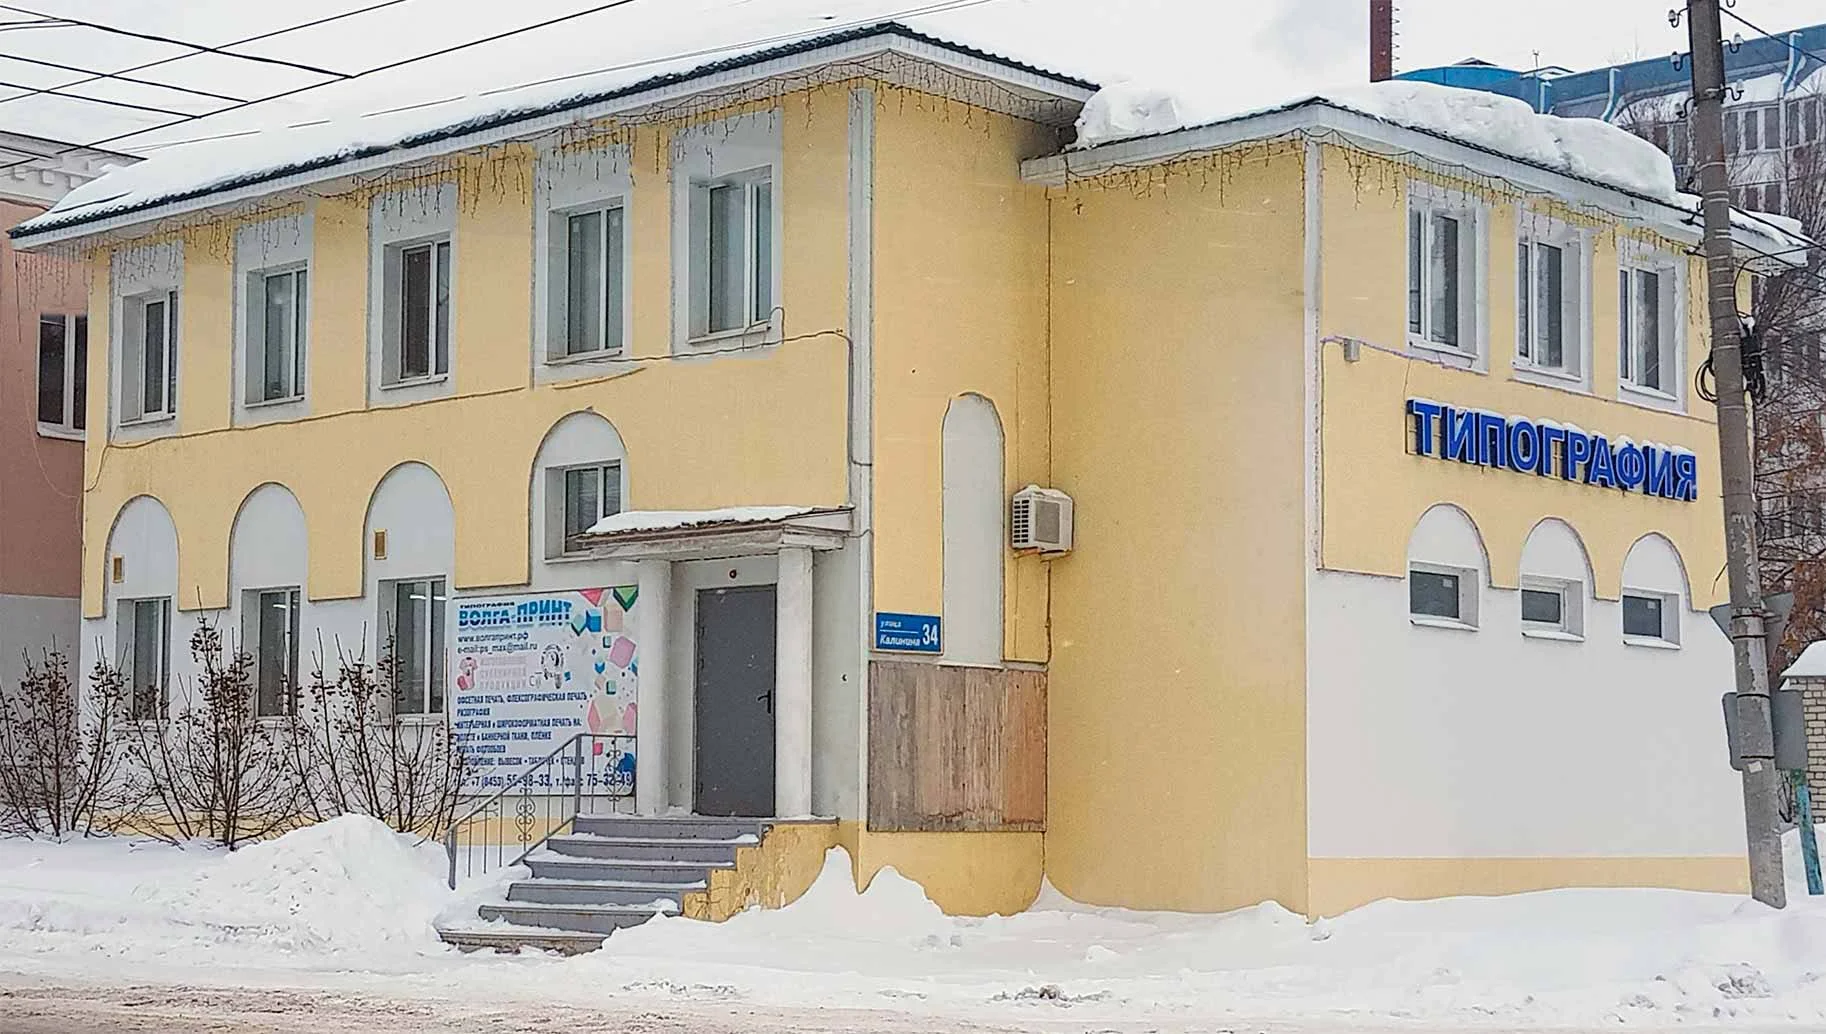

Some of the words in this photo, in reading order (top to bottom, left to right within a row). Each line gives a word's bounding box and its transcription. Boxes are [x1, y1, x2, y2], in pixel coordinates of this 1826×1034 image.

[1408, 400, 1697, 501] ТИПОГРАФИЯ
[880, 635, 920, 647] Калинина
[922, 623, 939, 646] 34
